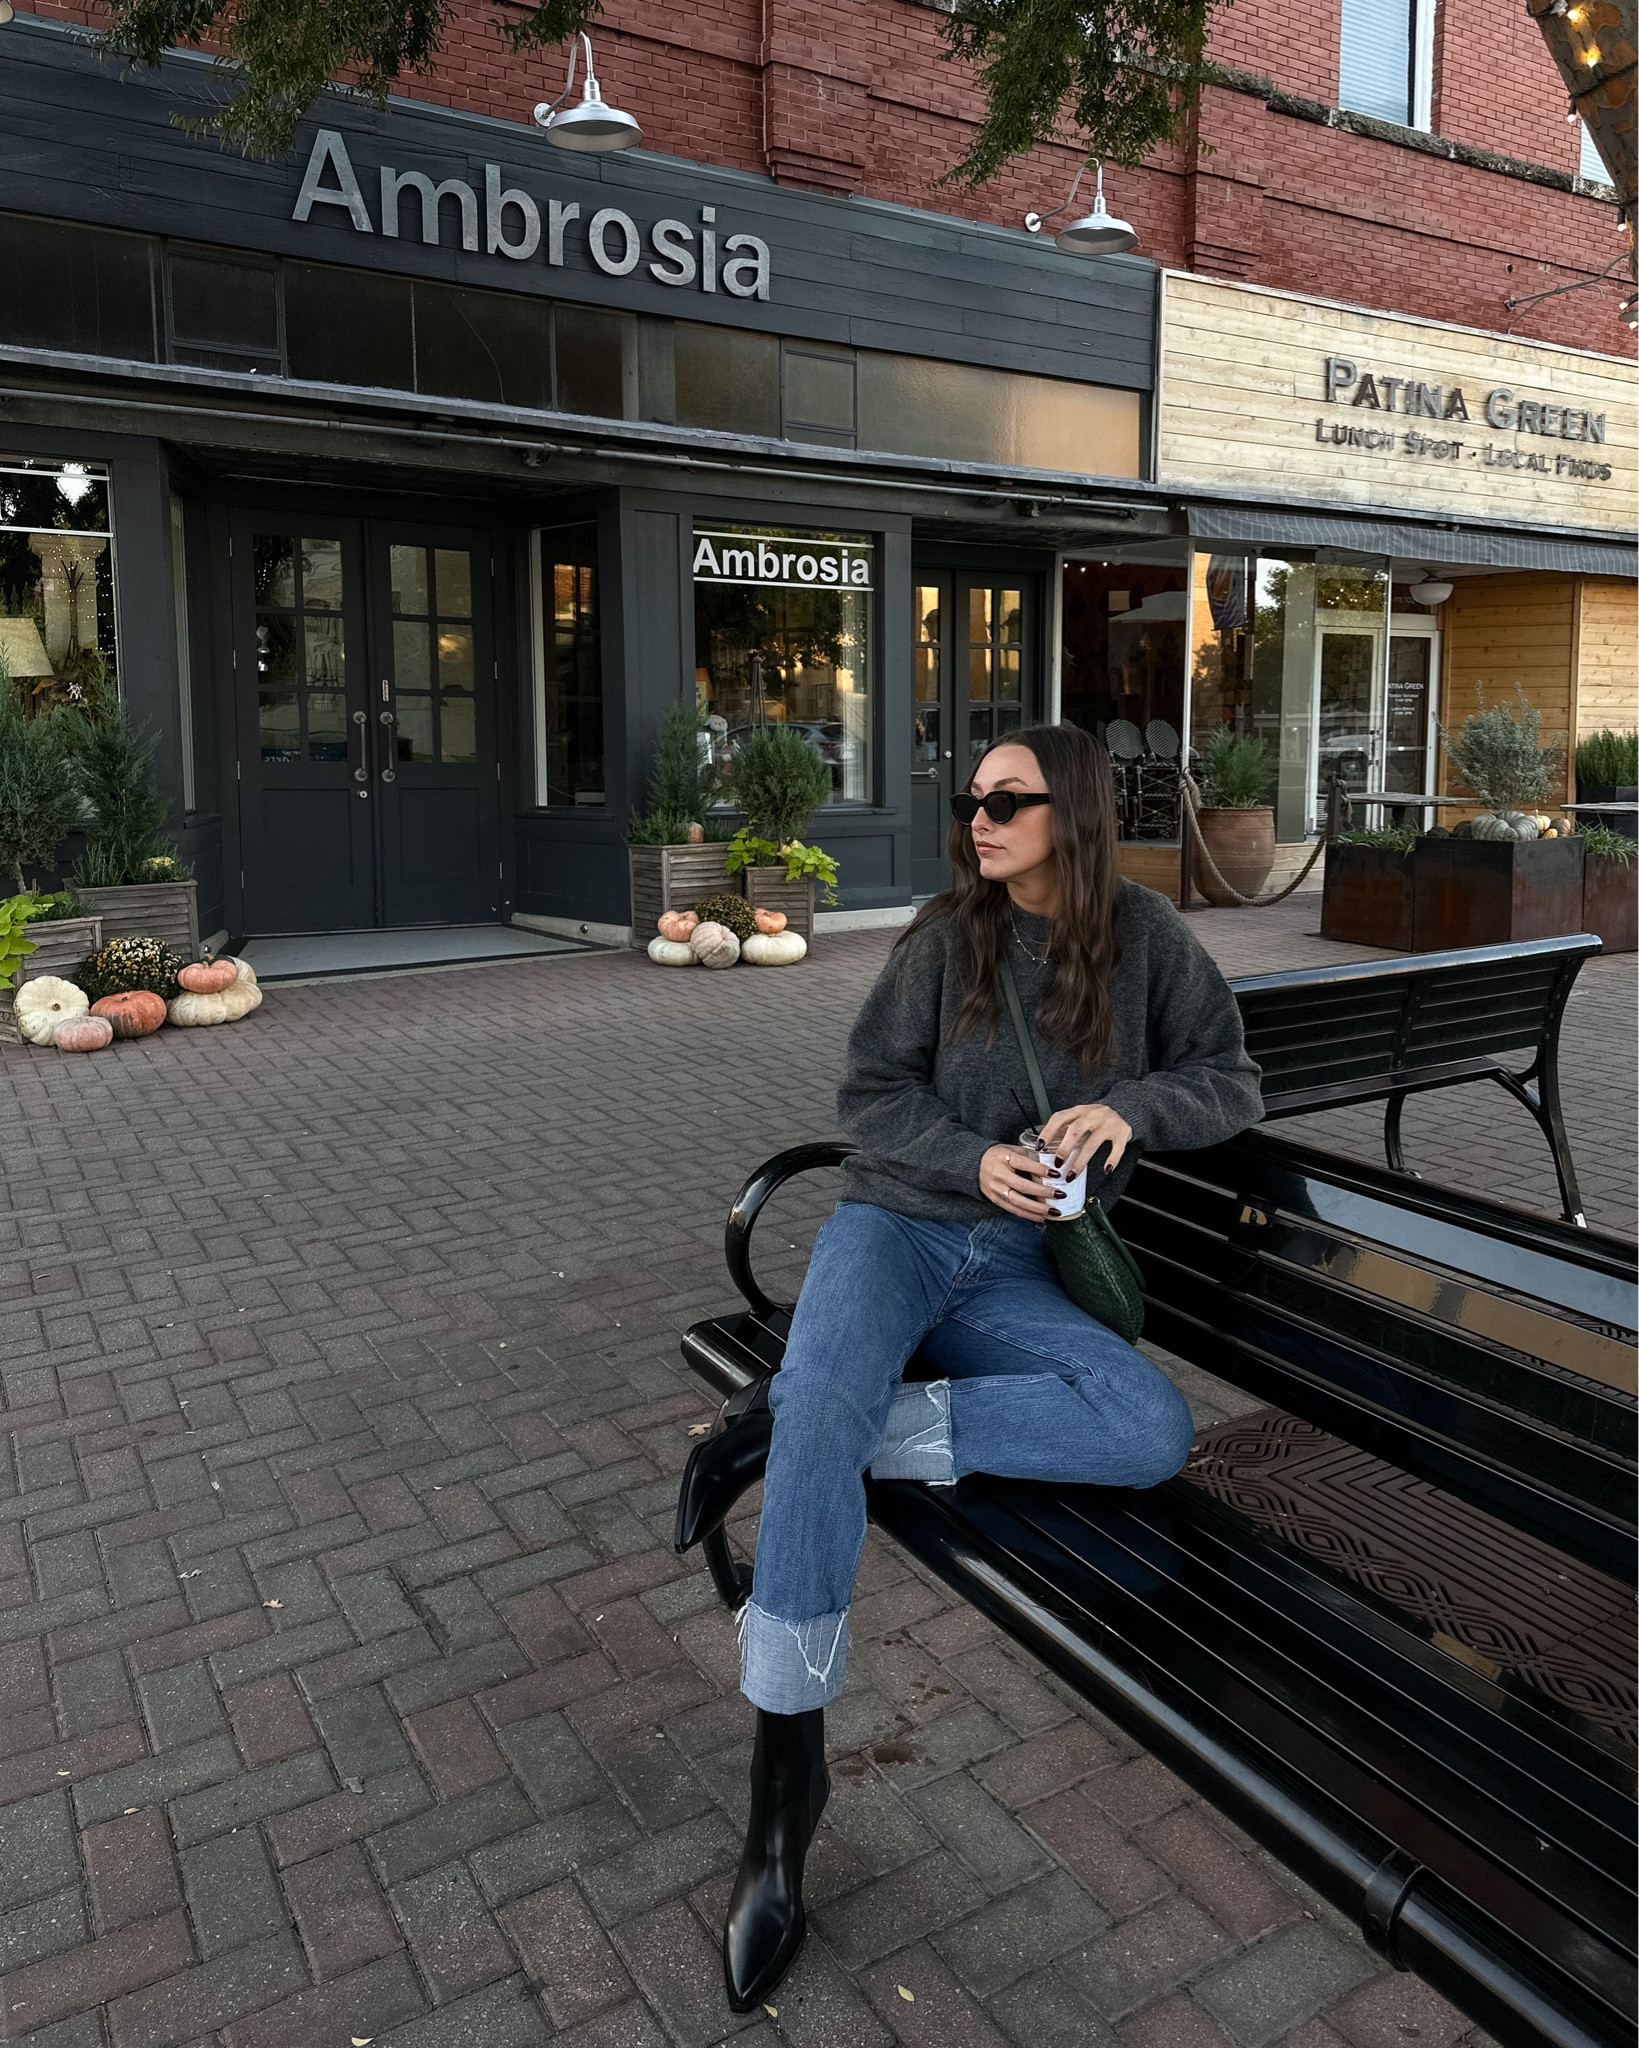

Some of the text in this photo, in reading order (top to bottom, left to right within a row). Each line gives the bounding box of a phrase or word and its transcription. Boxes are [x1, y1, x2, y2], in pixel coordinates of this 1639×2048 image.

[292, 129, 771, 301] Ambrosia
[1325, 356, 1607, 444] PATINA GREEN
[1316, 418, 1612, 481] LUNCH SPOT LOCAL FINDS
[693, 538, 870, 585] Ambrosia
